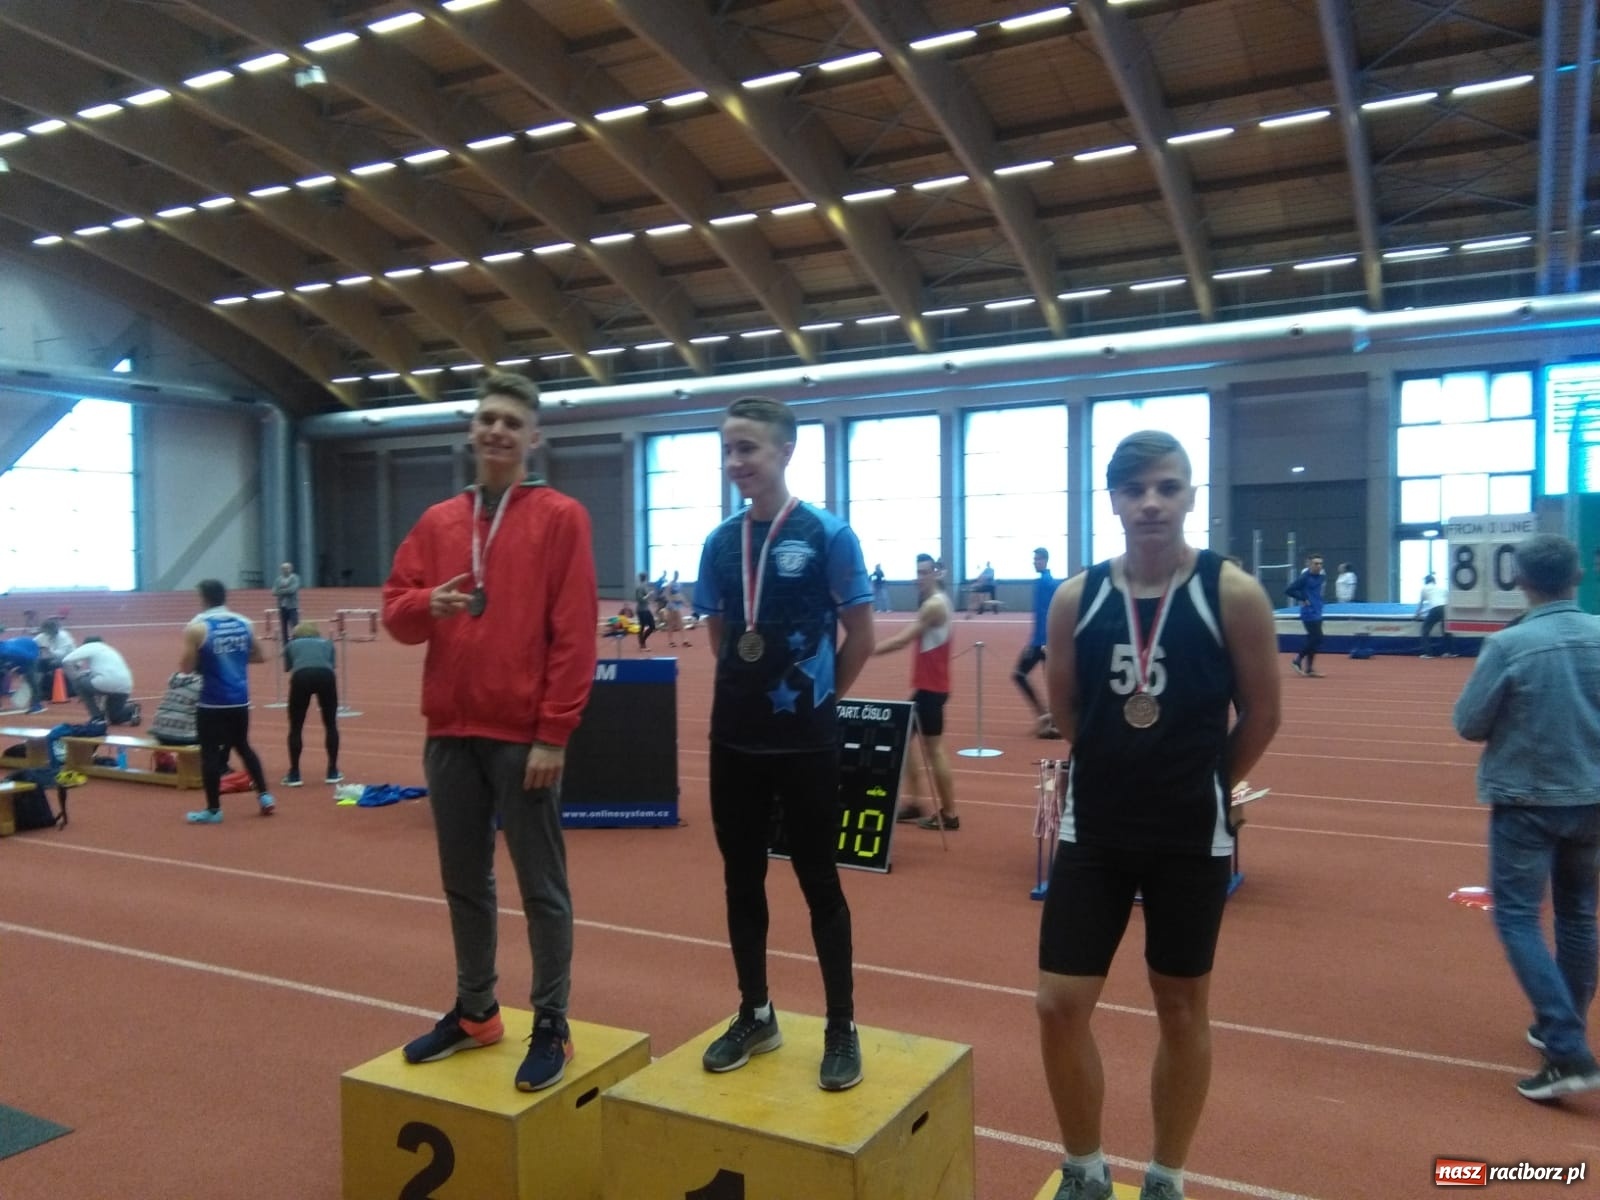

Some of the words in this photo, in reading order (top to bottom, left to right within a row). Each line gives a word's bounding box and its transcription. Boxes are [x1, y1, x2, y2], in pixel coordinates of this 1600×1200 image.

[1109, 643, 1168, 696] 56
[836, 705, 860, 719] TART.
[861, 704, 892, 721] ČÍSLO
[838, 809, 884, 857] 10
[397, 1121, 455, 1200] 2
